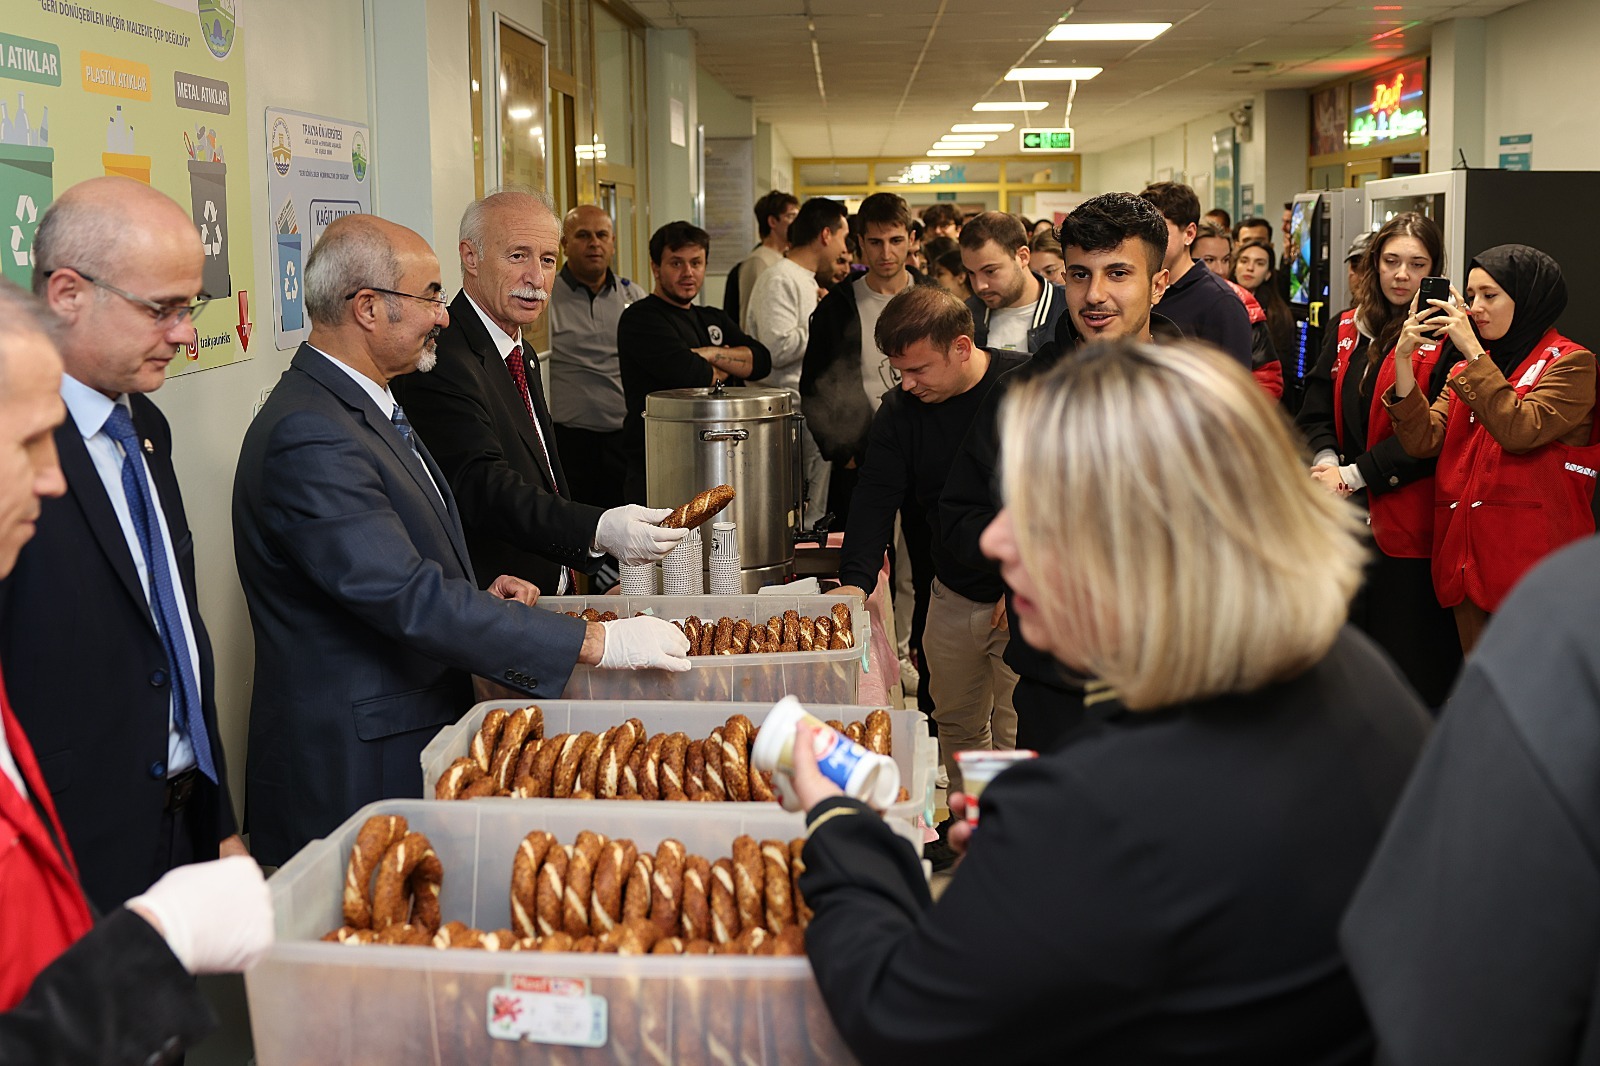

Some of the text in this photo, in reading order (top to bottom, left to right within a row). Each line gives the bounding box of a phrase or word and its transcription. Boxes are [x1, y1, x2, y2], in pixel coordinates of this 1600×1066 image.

[59, 0, 104, 25] DÖNÜŞEBİLEN
[105, 12, 126, 32] HİÇBİR
[126, 20, 152, 39] MALZEME
[153, 26, 164, 42] ÇÖP
[165, 30, 190, 48] DEĞİLDİR"
[8, 45, 58, 76] ATIKLAR
[86, 65, 148, 92] PLASTİK ATIKLAR
[177, 81, 228, 106] METAL ATIKLAR
[315, 206, 333, 226] KAĞIT
[200, 332, 231, 350] trakyaunisks
